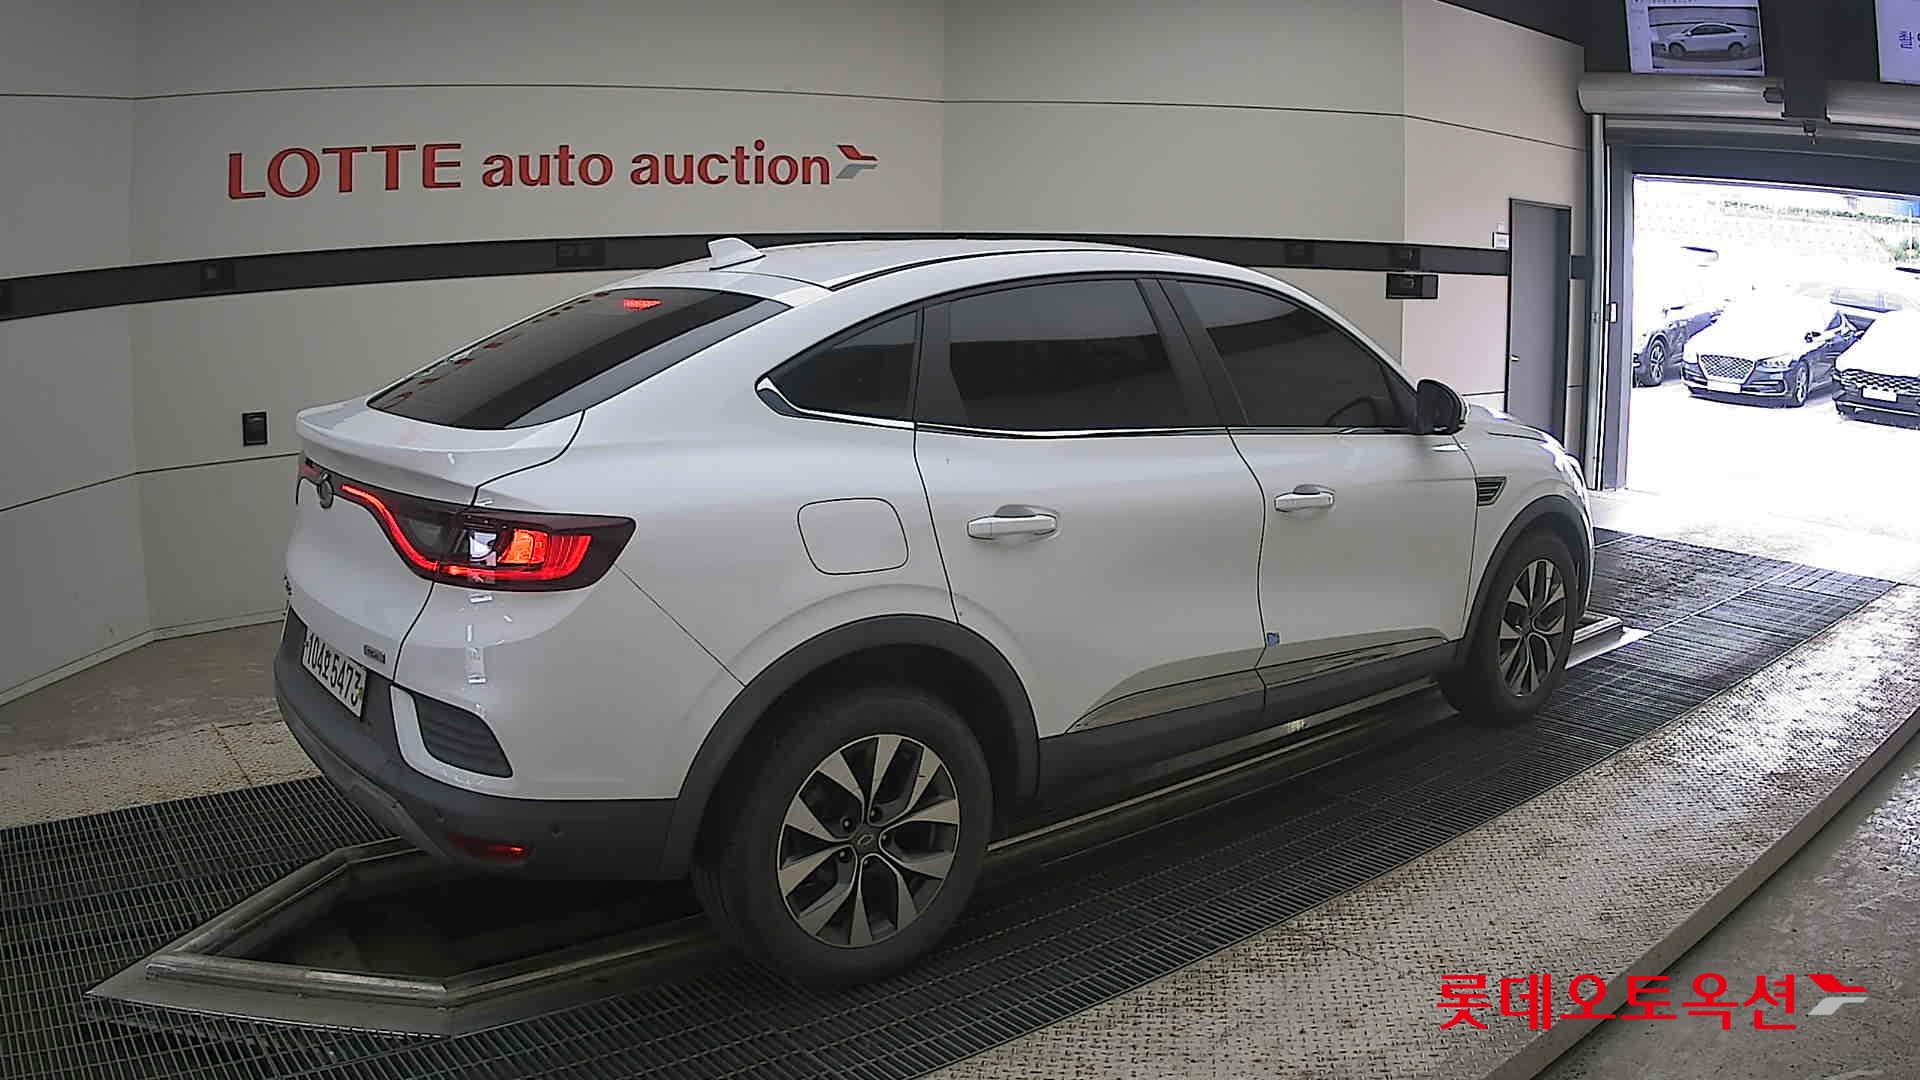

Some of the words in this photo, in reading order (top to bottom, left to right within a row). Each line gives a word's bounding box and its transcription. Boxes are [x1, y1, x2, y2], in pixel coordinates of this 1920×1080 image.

[228, 143, 462, 199] LOTTE
[481, 144, 613, 188] auto
[629, 139, 831, 187] auction
